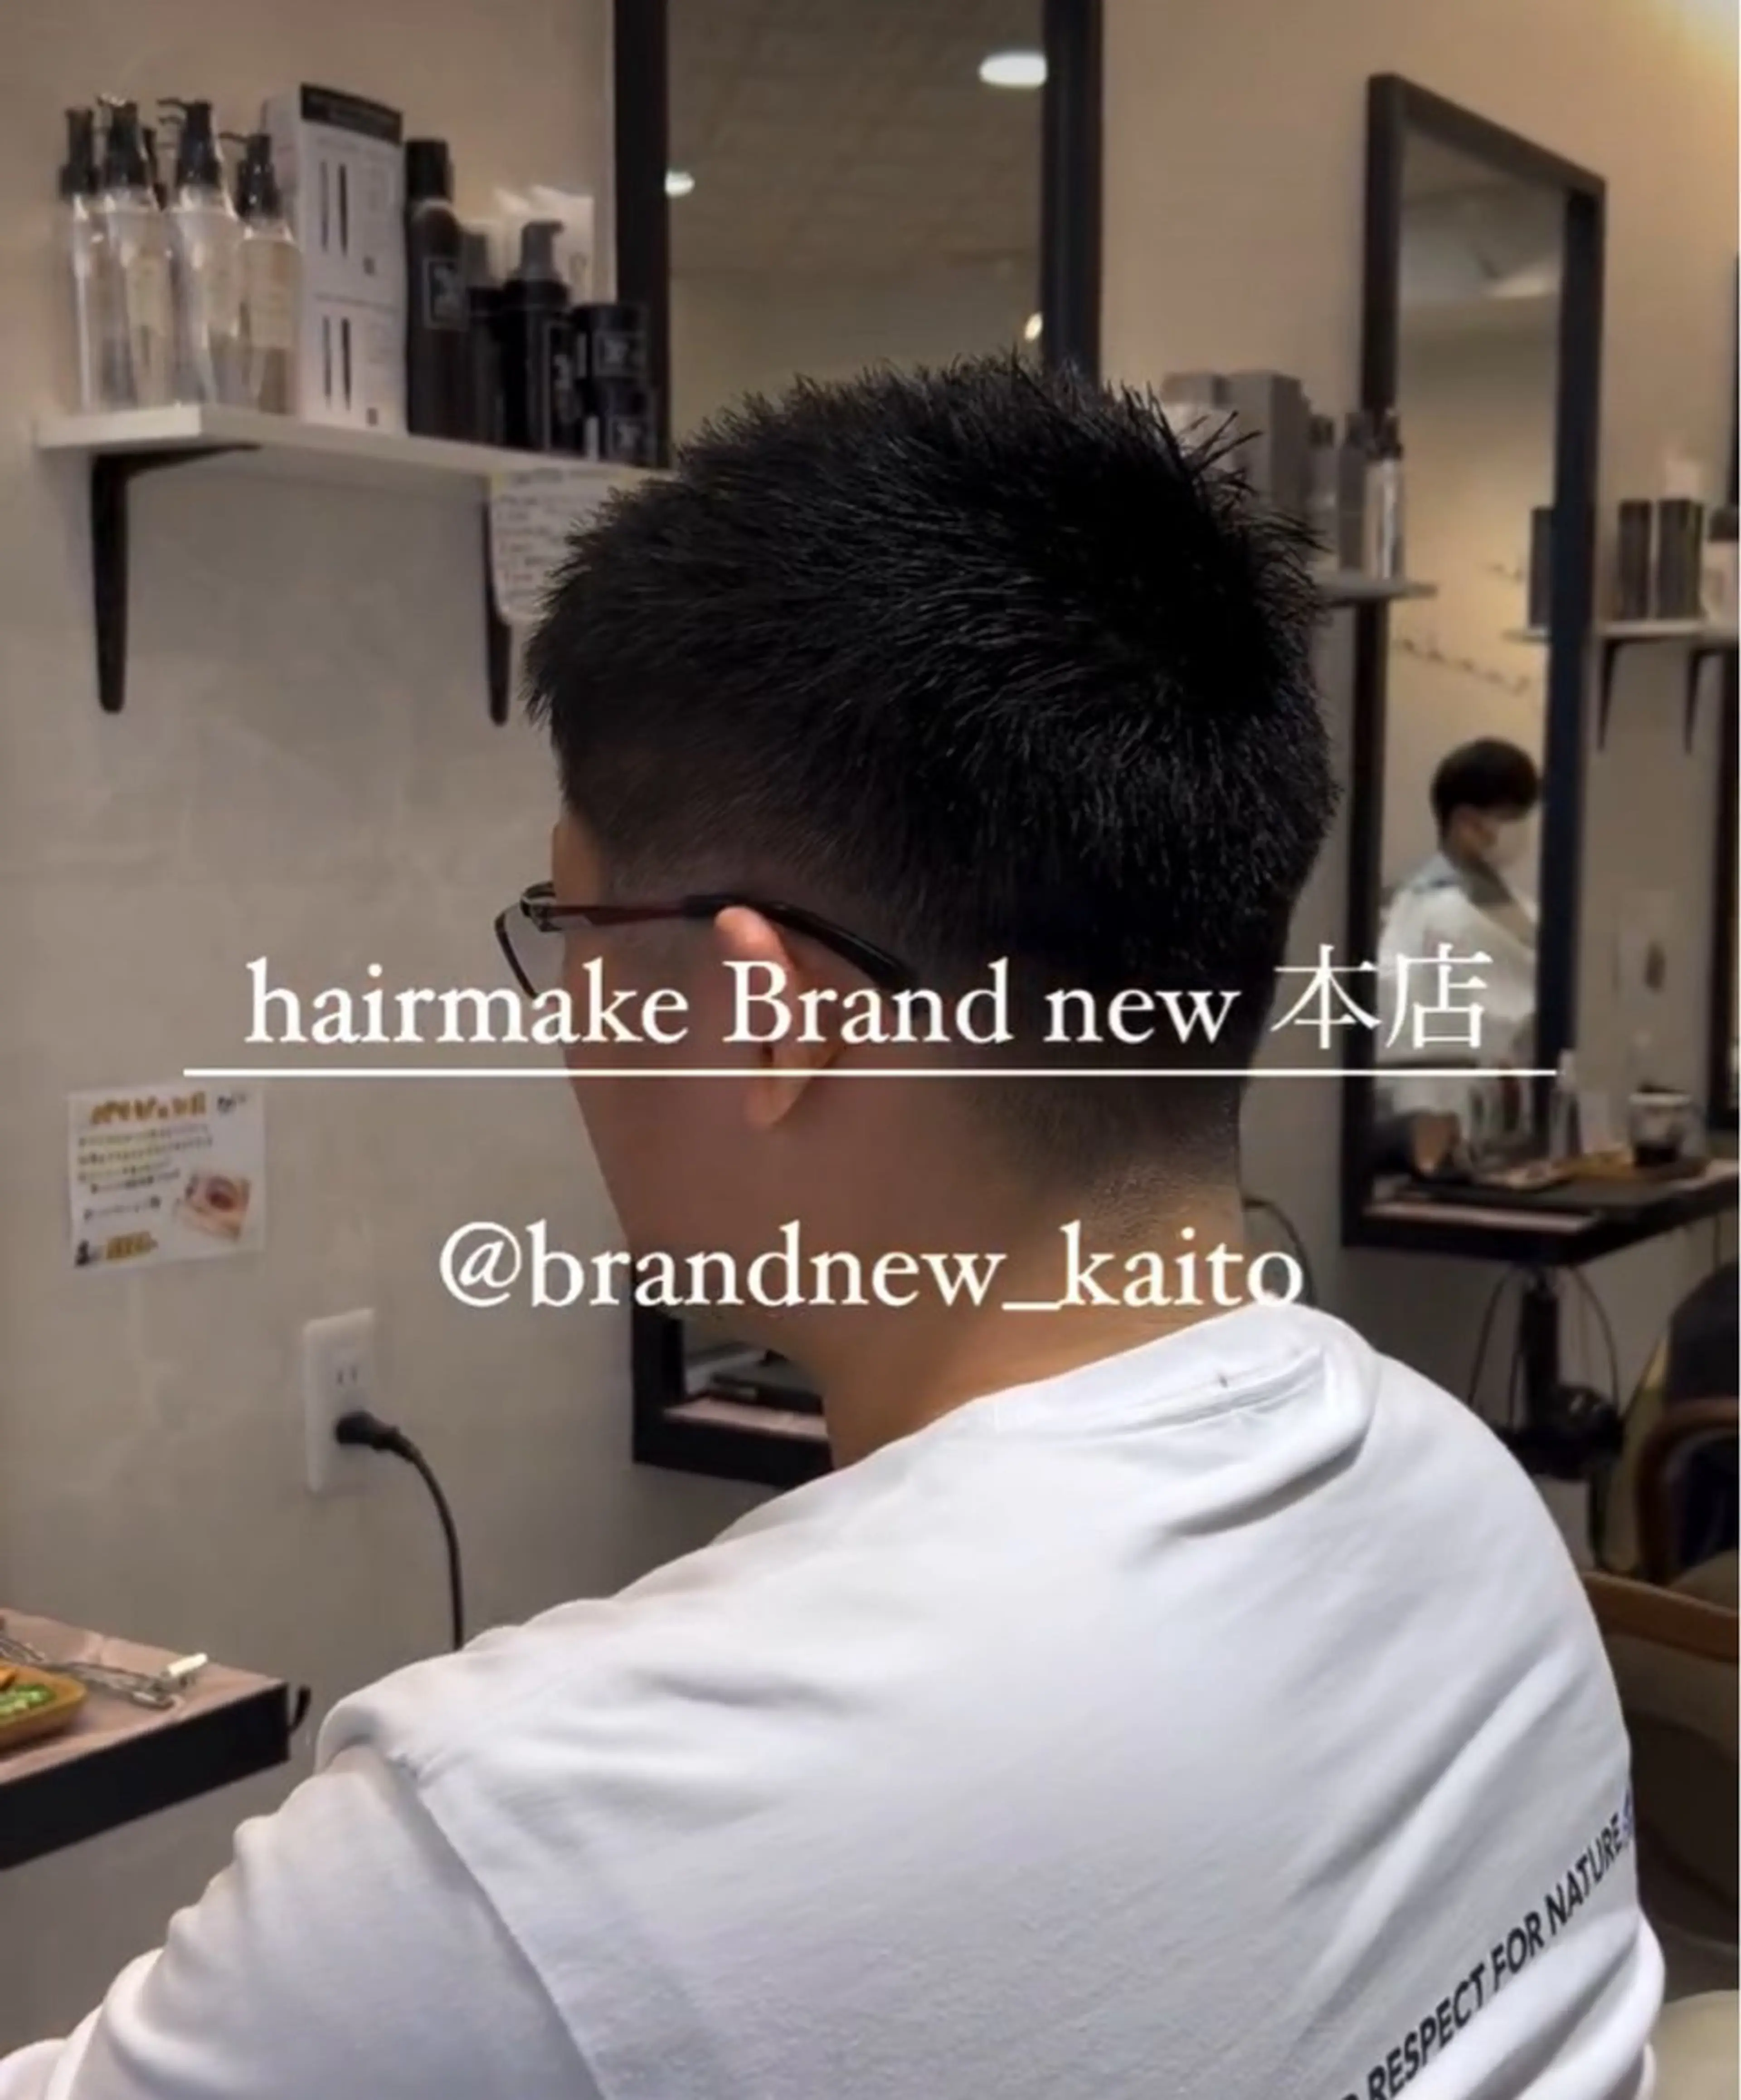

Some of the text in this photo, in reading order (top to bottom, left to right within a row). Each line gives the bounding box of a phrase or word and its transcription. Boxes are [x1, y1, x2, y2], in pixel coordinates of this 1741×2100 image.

[1367, 1963, 1485, 2100] RESPECT
[1490, 1910, 1545, 1993] FOR
[1544, 1813, 1623, 1936] NATURE
